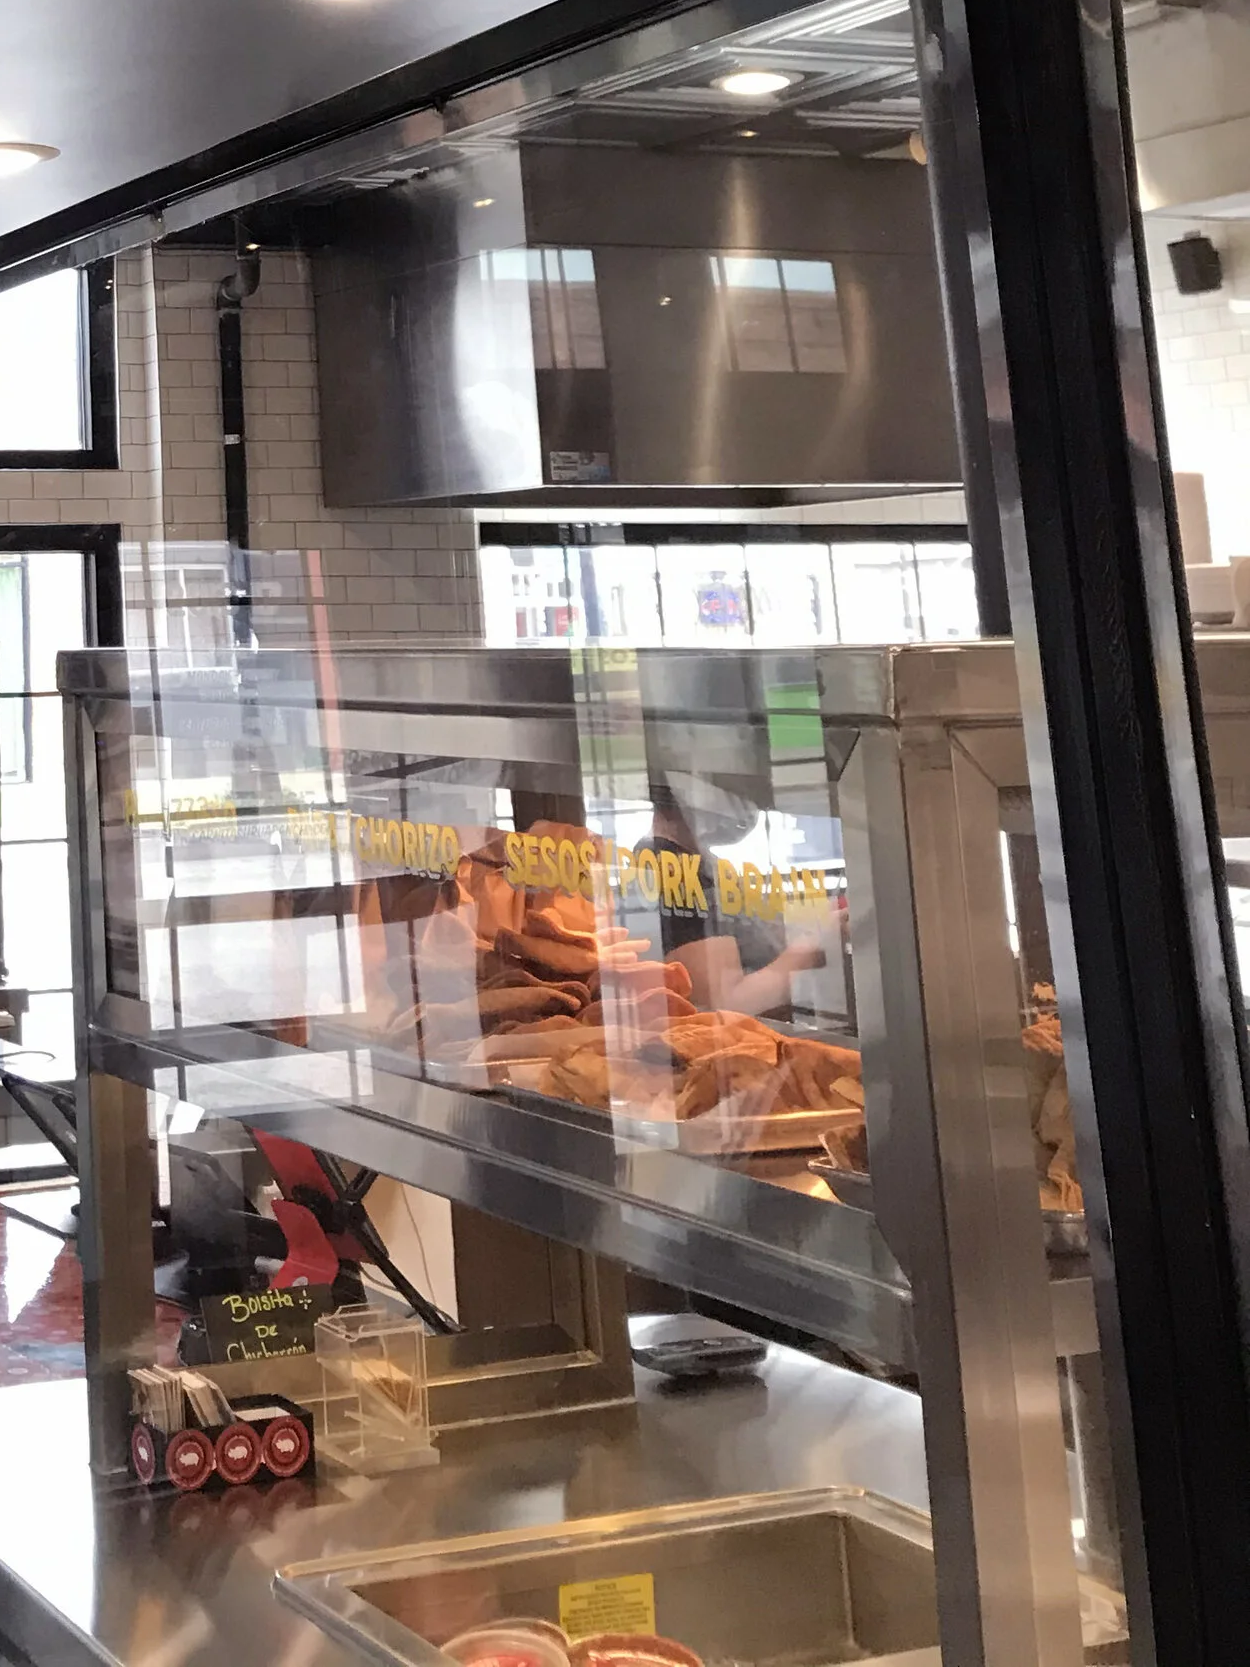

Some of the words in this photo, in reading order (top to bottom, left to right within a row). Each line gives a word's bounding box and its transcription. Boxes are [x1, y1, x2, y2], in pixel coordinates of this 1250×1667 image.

[356, 816, 460, 875] CHORIZO
[505, 833, 598, 896] SESOS
[616, 846, 709, 914] PORK
[717, 858, 830, 926] BRAIN
[222, 1288, 294, 1323] Bolsita
